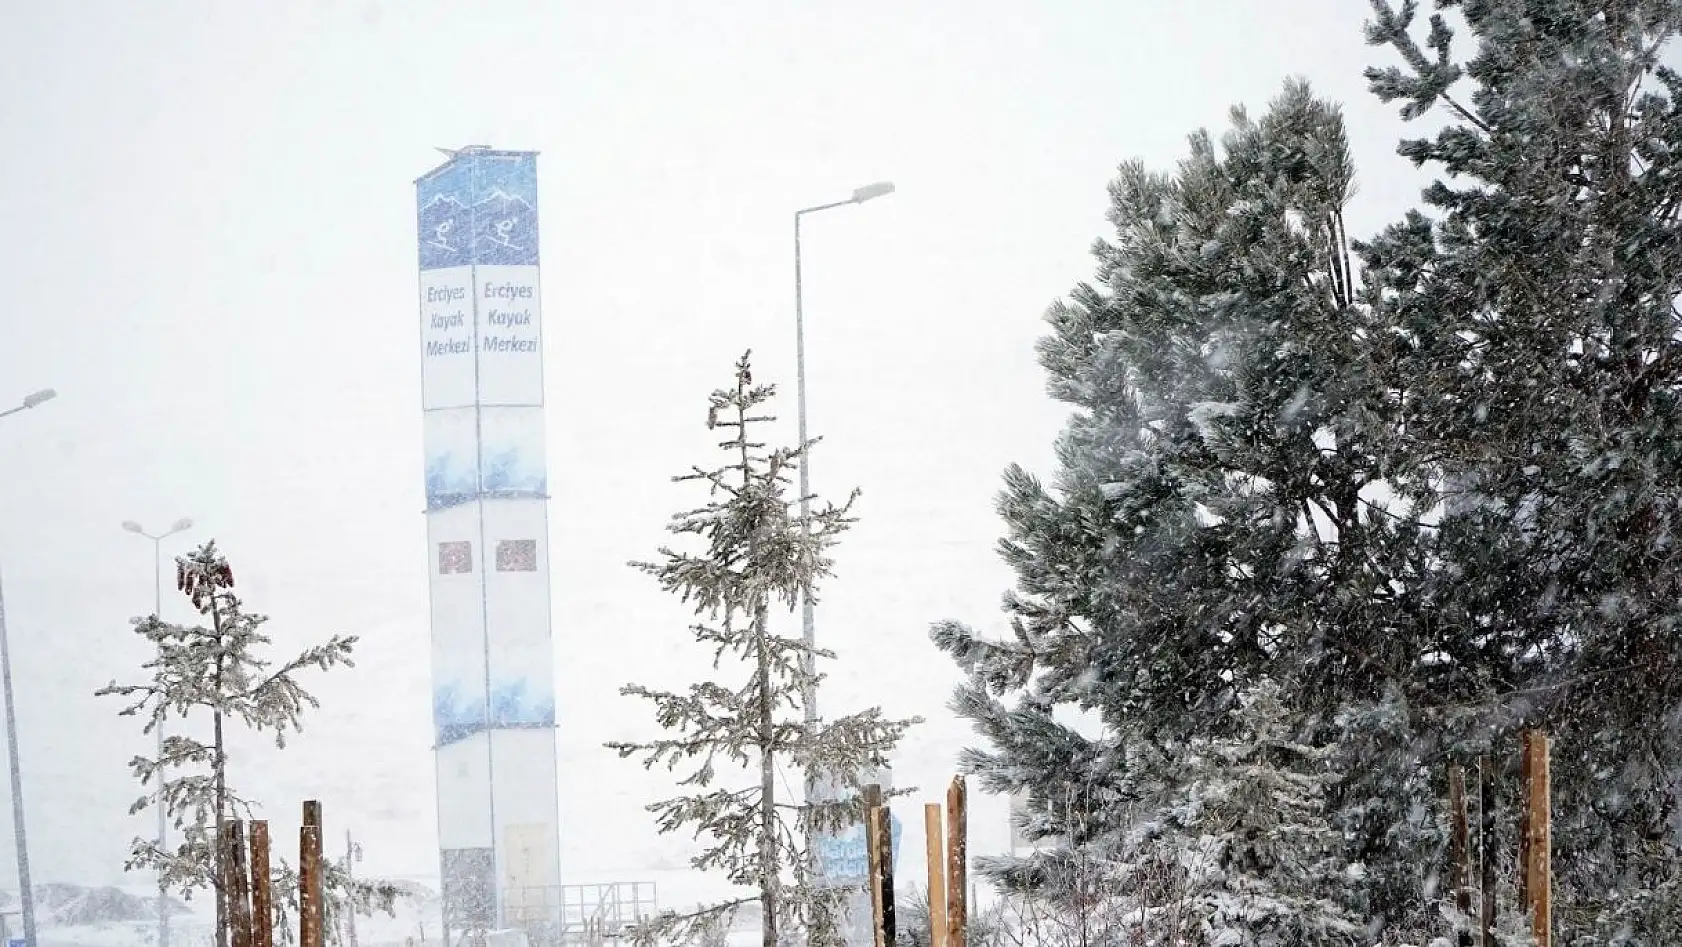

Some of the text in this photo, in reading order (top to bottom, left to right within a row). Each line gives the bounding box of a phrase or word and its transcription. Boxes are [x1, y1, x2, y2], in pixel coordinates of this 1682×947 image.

[427, 286, 465, 304] Erciyes
[484, 281, 533, 301] Erciyes
[431, 310, 465, 332] Kayak
[487, 309, 531, 329] Kayak
[426, 335, 470, 357] Merkezi
[482, 334, 538, 353] Merkezi
